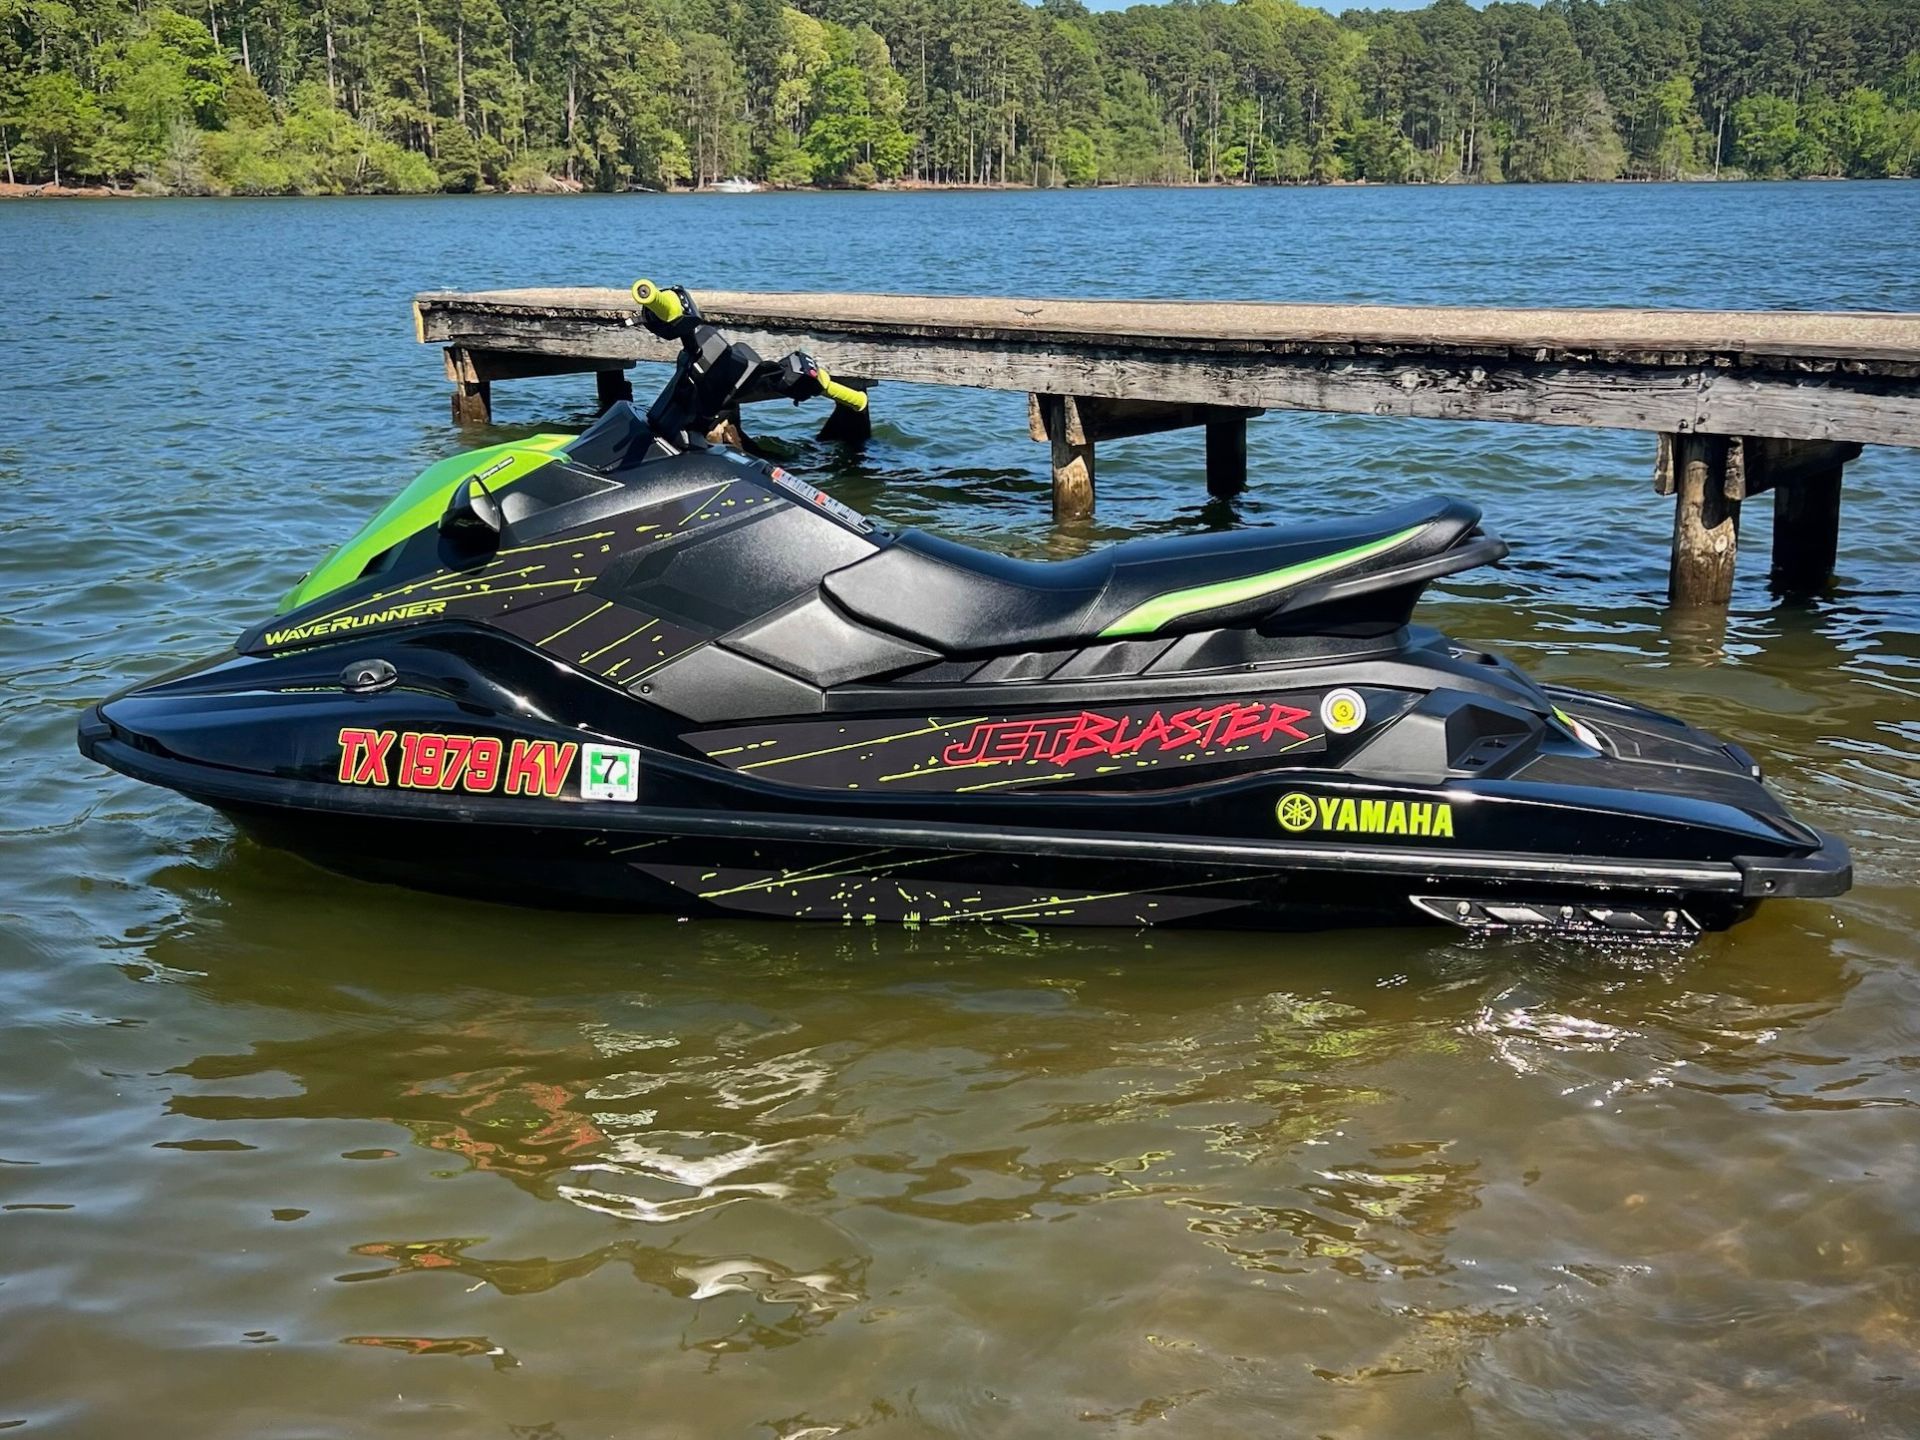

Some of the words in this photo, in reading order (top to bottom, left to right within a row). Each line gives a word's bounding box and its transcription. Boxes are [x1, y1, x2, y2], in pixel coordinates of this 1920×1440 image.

[1339, 704, 1349, 718] 3
[338, 728, 397, 786] TX
[398, 732, 502, 792] 1979
[504, 739, 578, 797] KV
[600, 754, 619, 784] 7
[1318, 797, 1454, 838] YAMAHA
